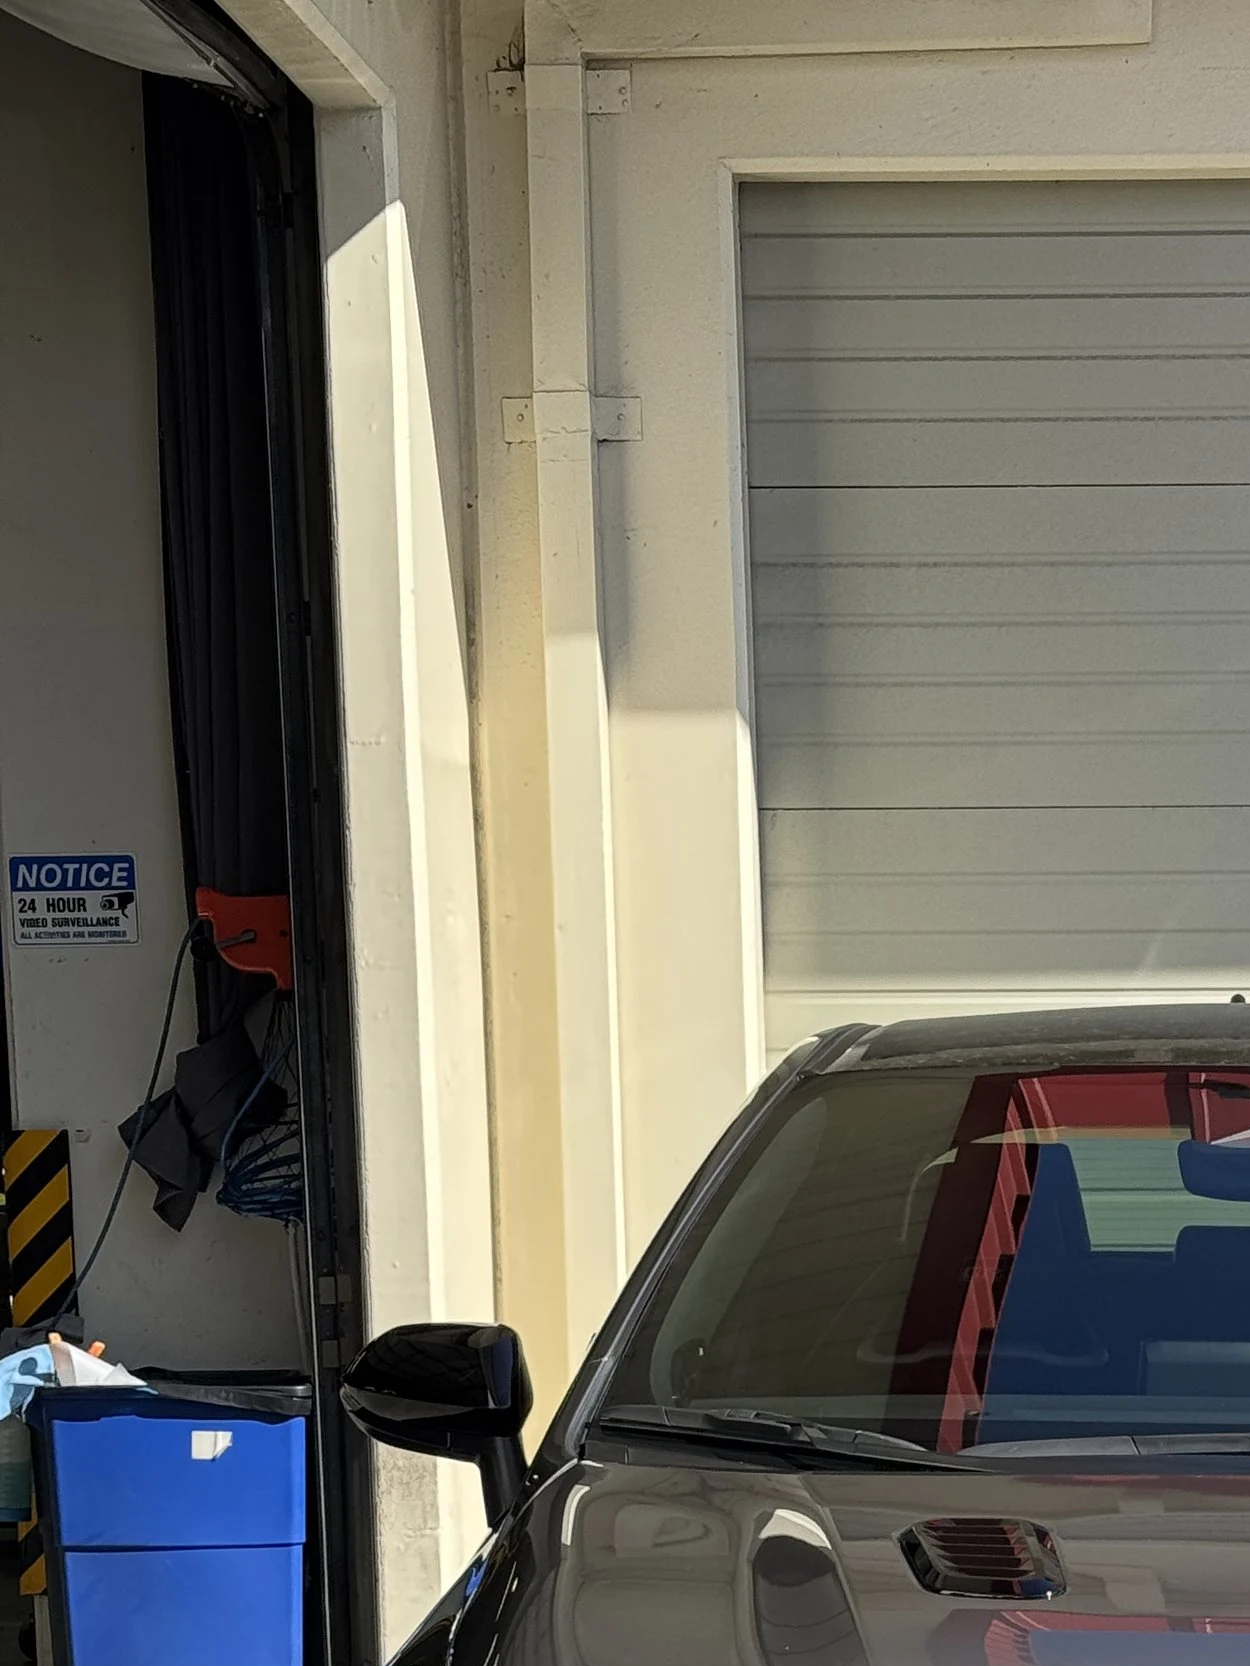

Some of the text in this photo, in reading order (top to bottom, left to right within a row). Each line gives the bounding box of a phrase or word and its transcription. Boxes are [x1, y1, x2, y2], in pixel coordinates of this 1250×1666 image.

[16, 862, 130, 888] NOTICE
[18, 897, 87, 913] 24 HOUR
[19, 916, 120, 928] VIDEO SURVEILLANCE
